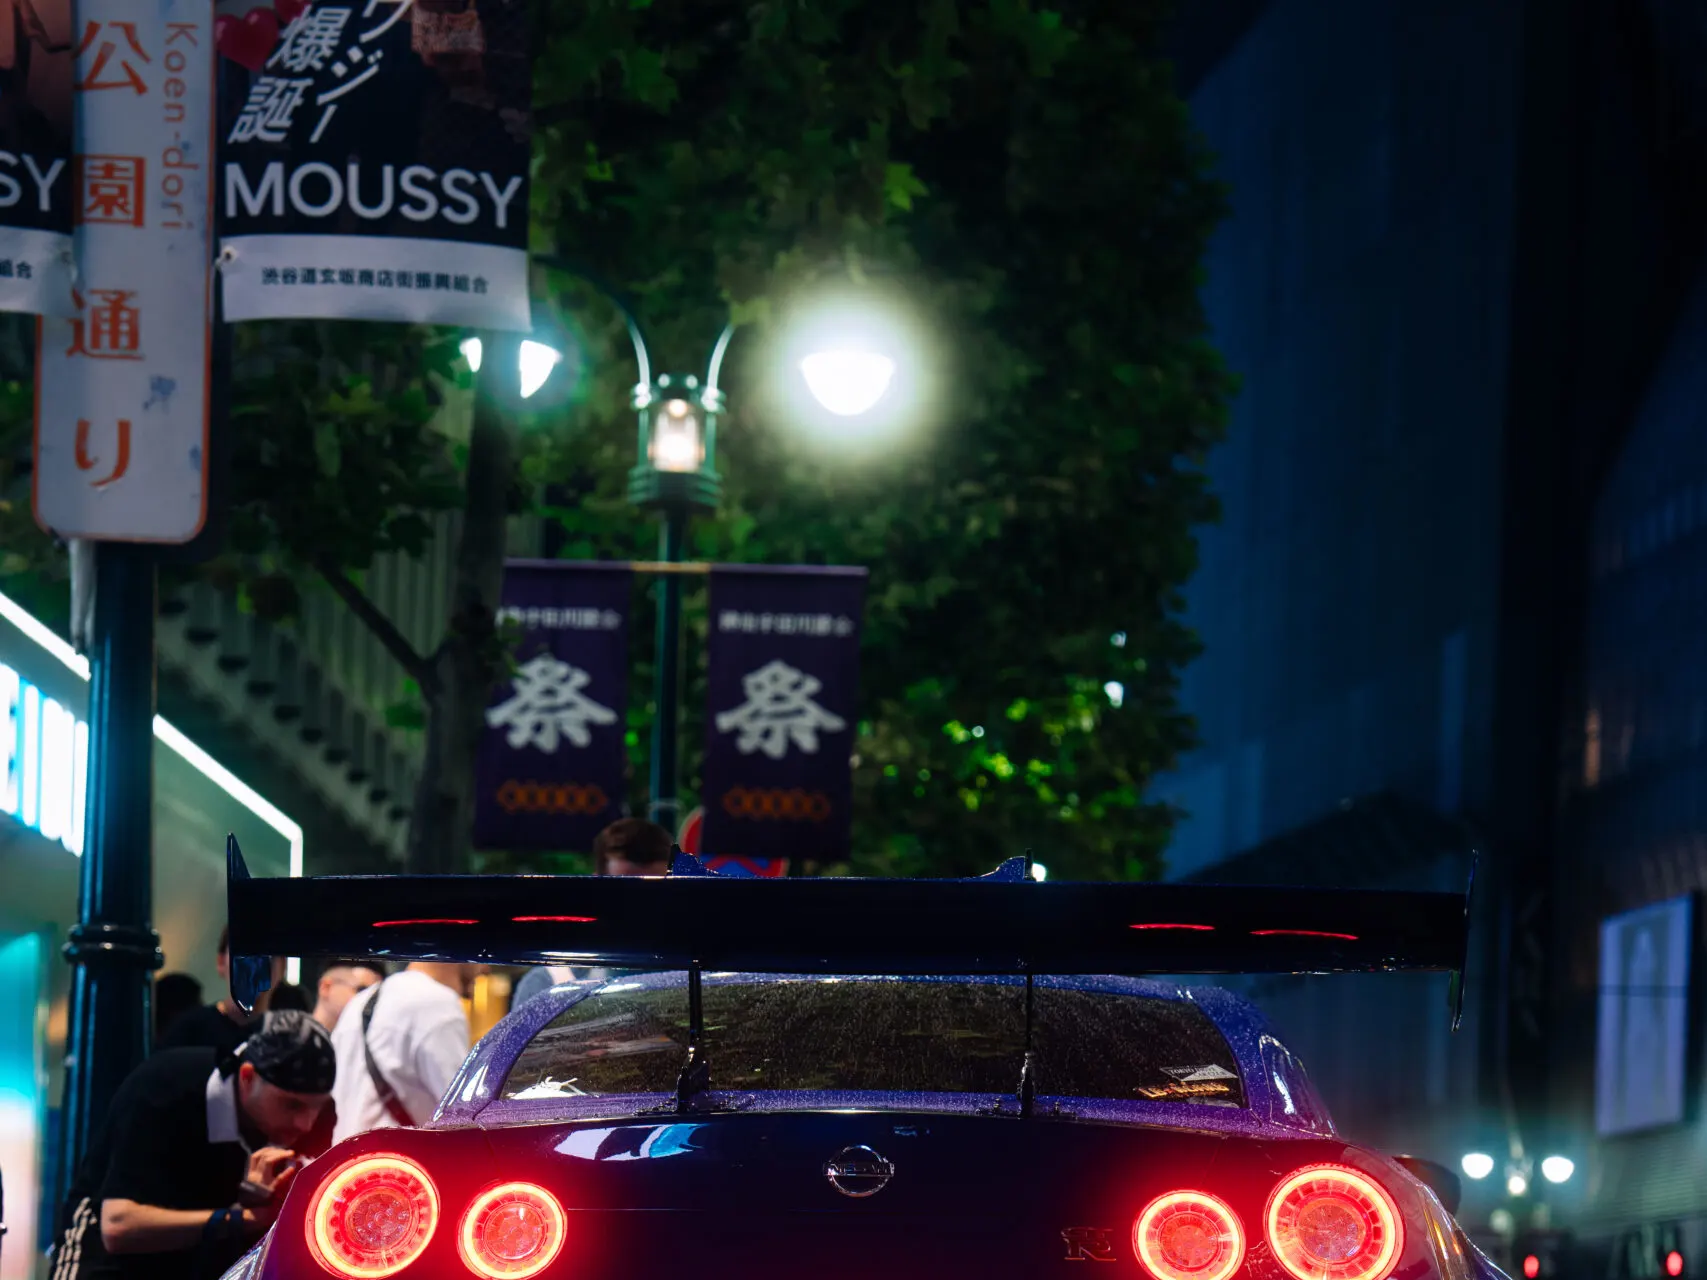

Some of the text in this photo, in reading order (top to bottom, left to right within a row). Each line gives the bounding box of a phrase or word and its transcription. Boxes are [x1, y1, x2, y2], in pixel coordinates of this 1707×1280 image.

[162, 22, 198, 230] Koen-dori
[227, 5, 352, 144] 爆誕
[67, 20, 151, 487] 公園通り
[225, 161, 523, 229] MOUSSY
[486, 652, 618, 754] 祭
[715, 659, 846, 760] 祭
